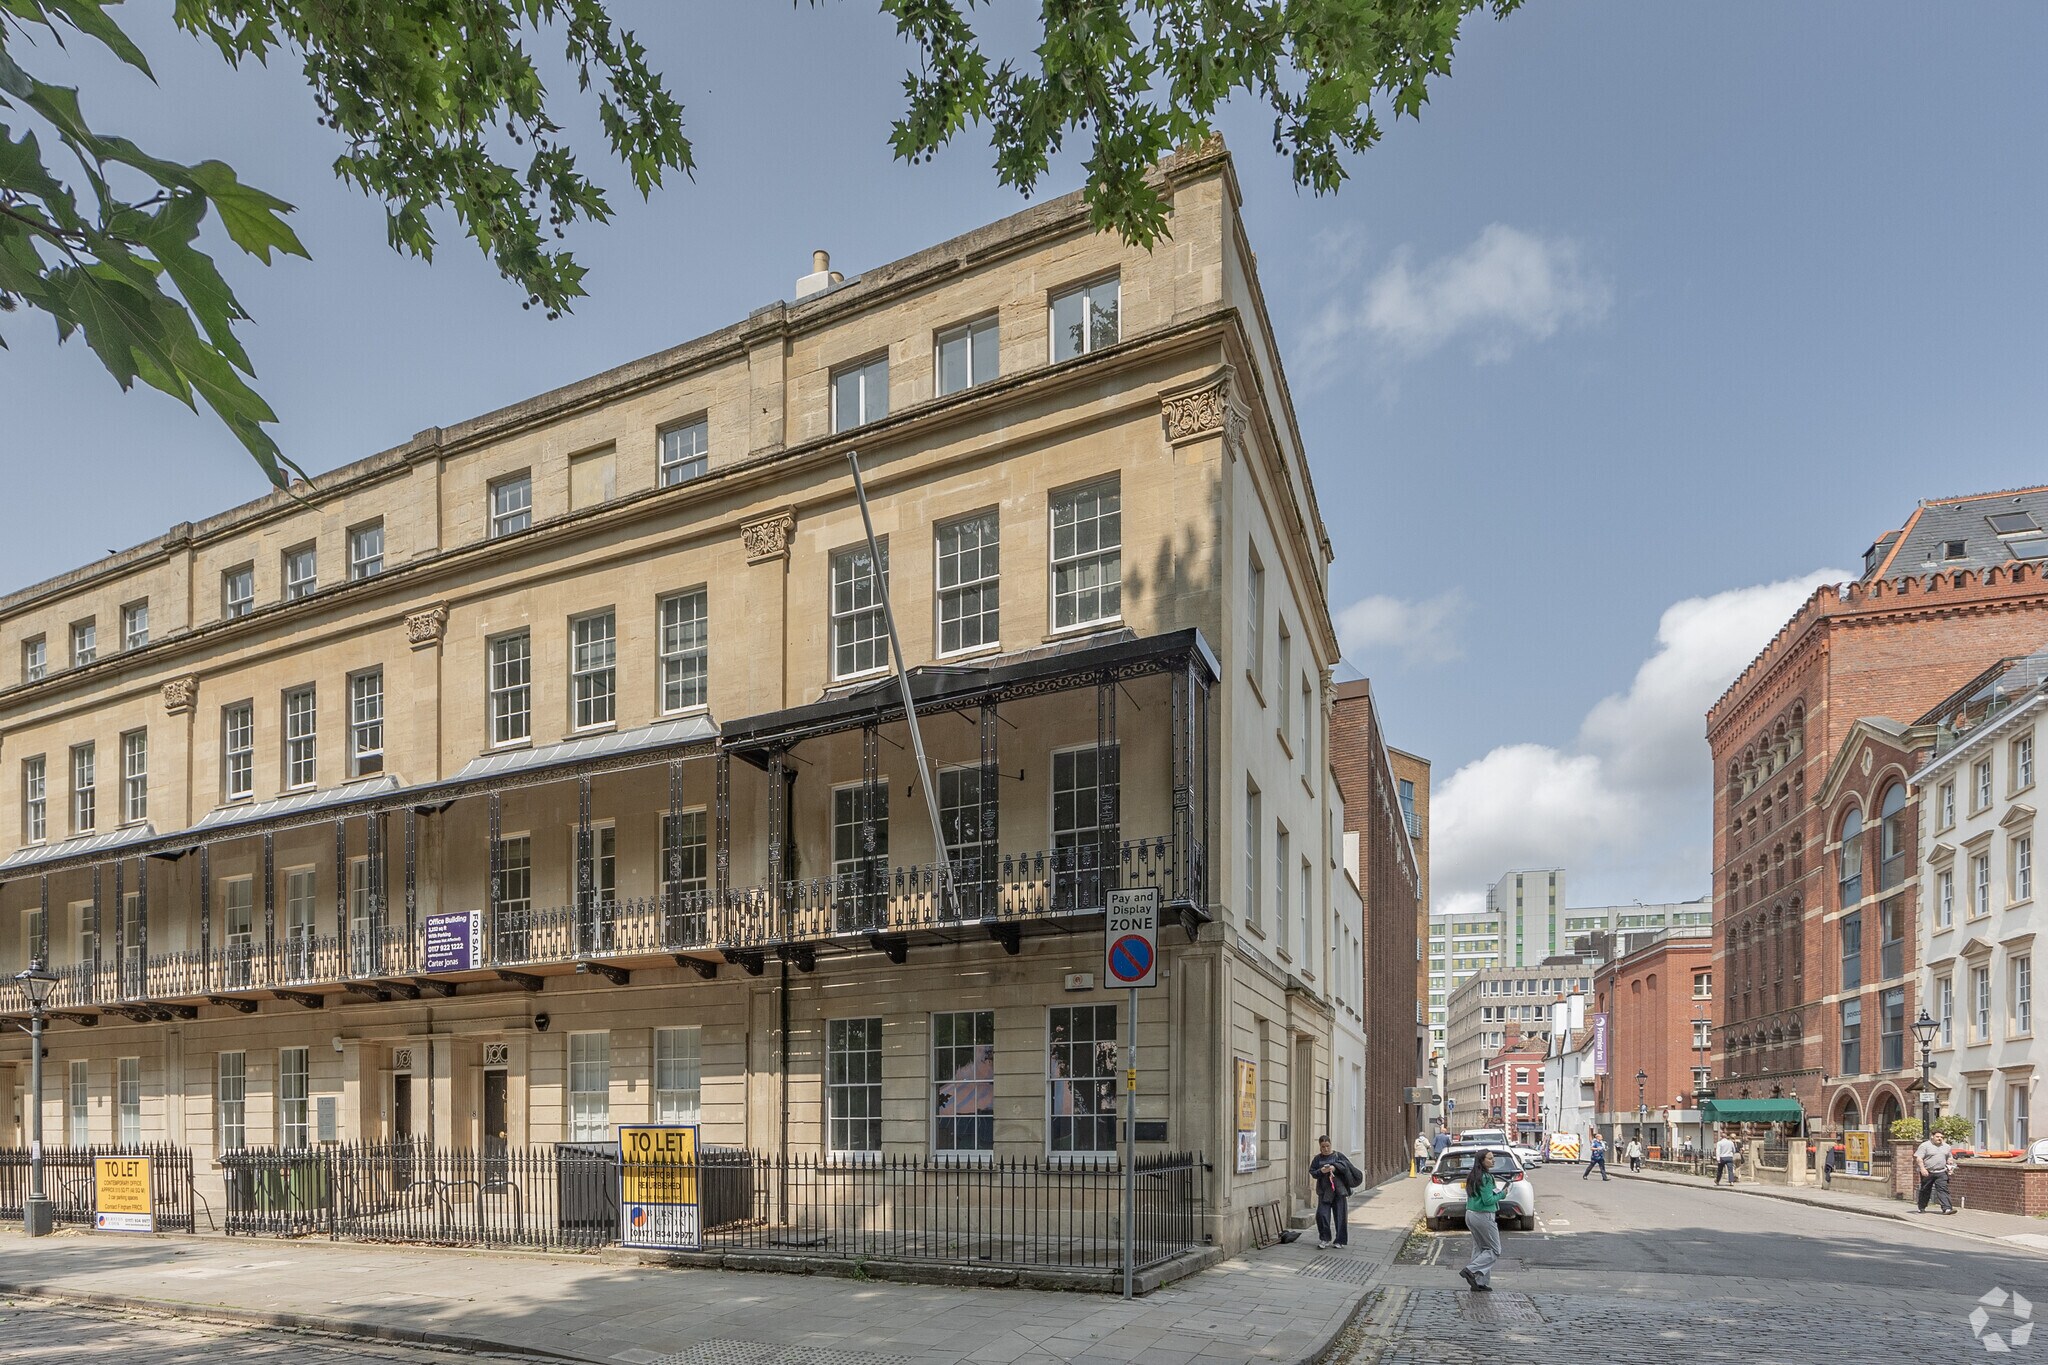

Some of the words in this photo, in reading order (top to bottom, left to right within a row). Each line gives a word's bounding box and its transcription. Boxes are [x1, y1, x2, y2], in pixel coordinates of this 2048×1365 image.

[1112, 894, 1131, 904] Pay
[1134, 892, 1153, 902] and
[1113, 905, 1152, 915] Display
[445, 916, 467, 924] Building
[1110, 918, 1153, 931] ZONE
[444, 959, 458, 967] Jonas
[628, 1132, 651, 1152] TO
[656, 1132, 686, 1152] LET
[105, 1161, 119, 1177] TO
[121, 1161, 140, 1177] LET
